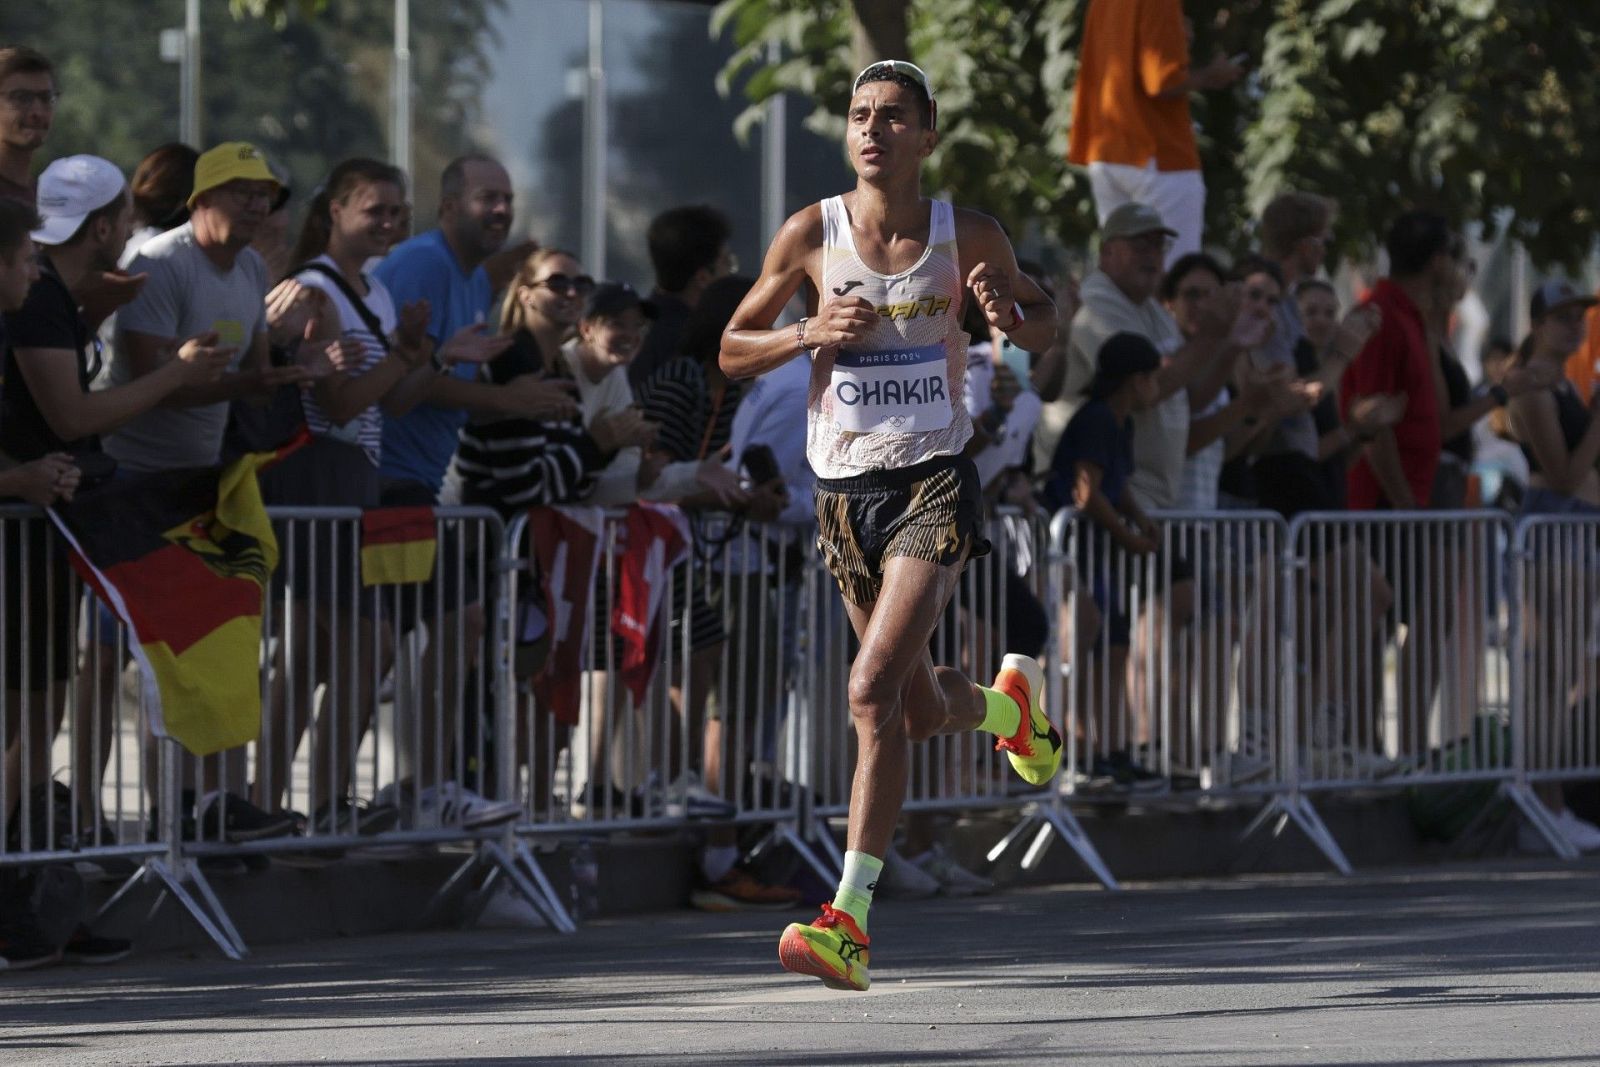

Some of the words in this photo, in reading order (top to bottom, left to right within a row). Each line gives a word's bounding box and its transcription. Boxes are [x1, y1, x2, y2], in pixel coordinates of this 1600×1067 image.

[873, 296, 952, 321] PAÑA
[859, 354, 890, 363] PARIS
[893, 352, 920, 362] 2024
[836, 376, 946, 406] CHAKIR
